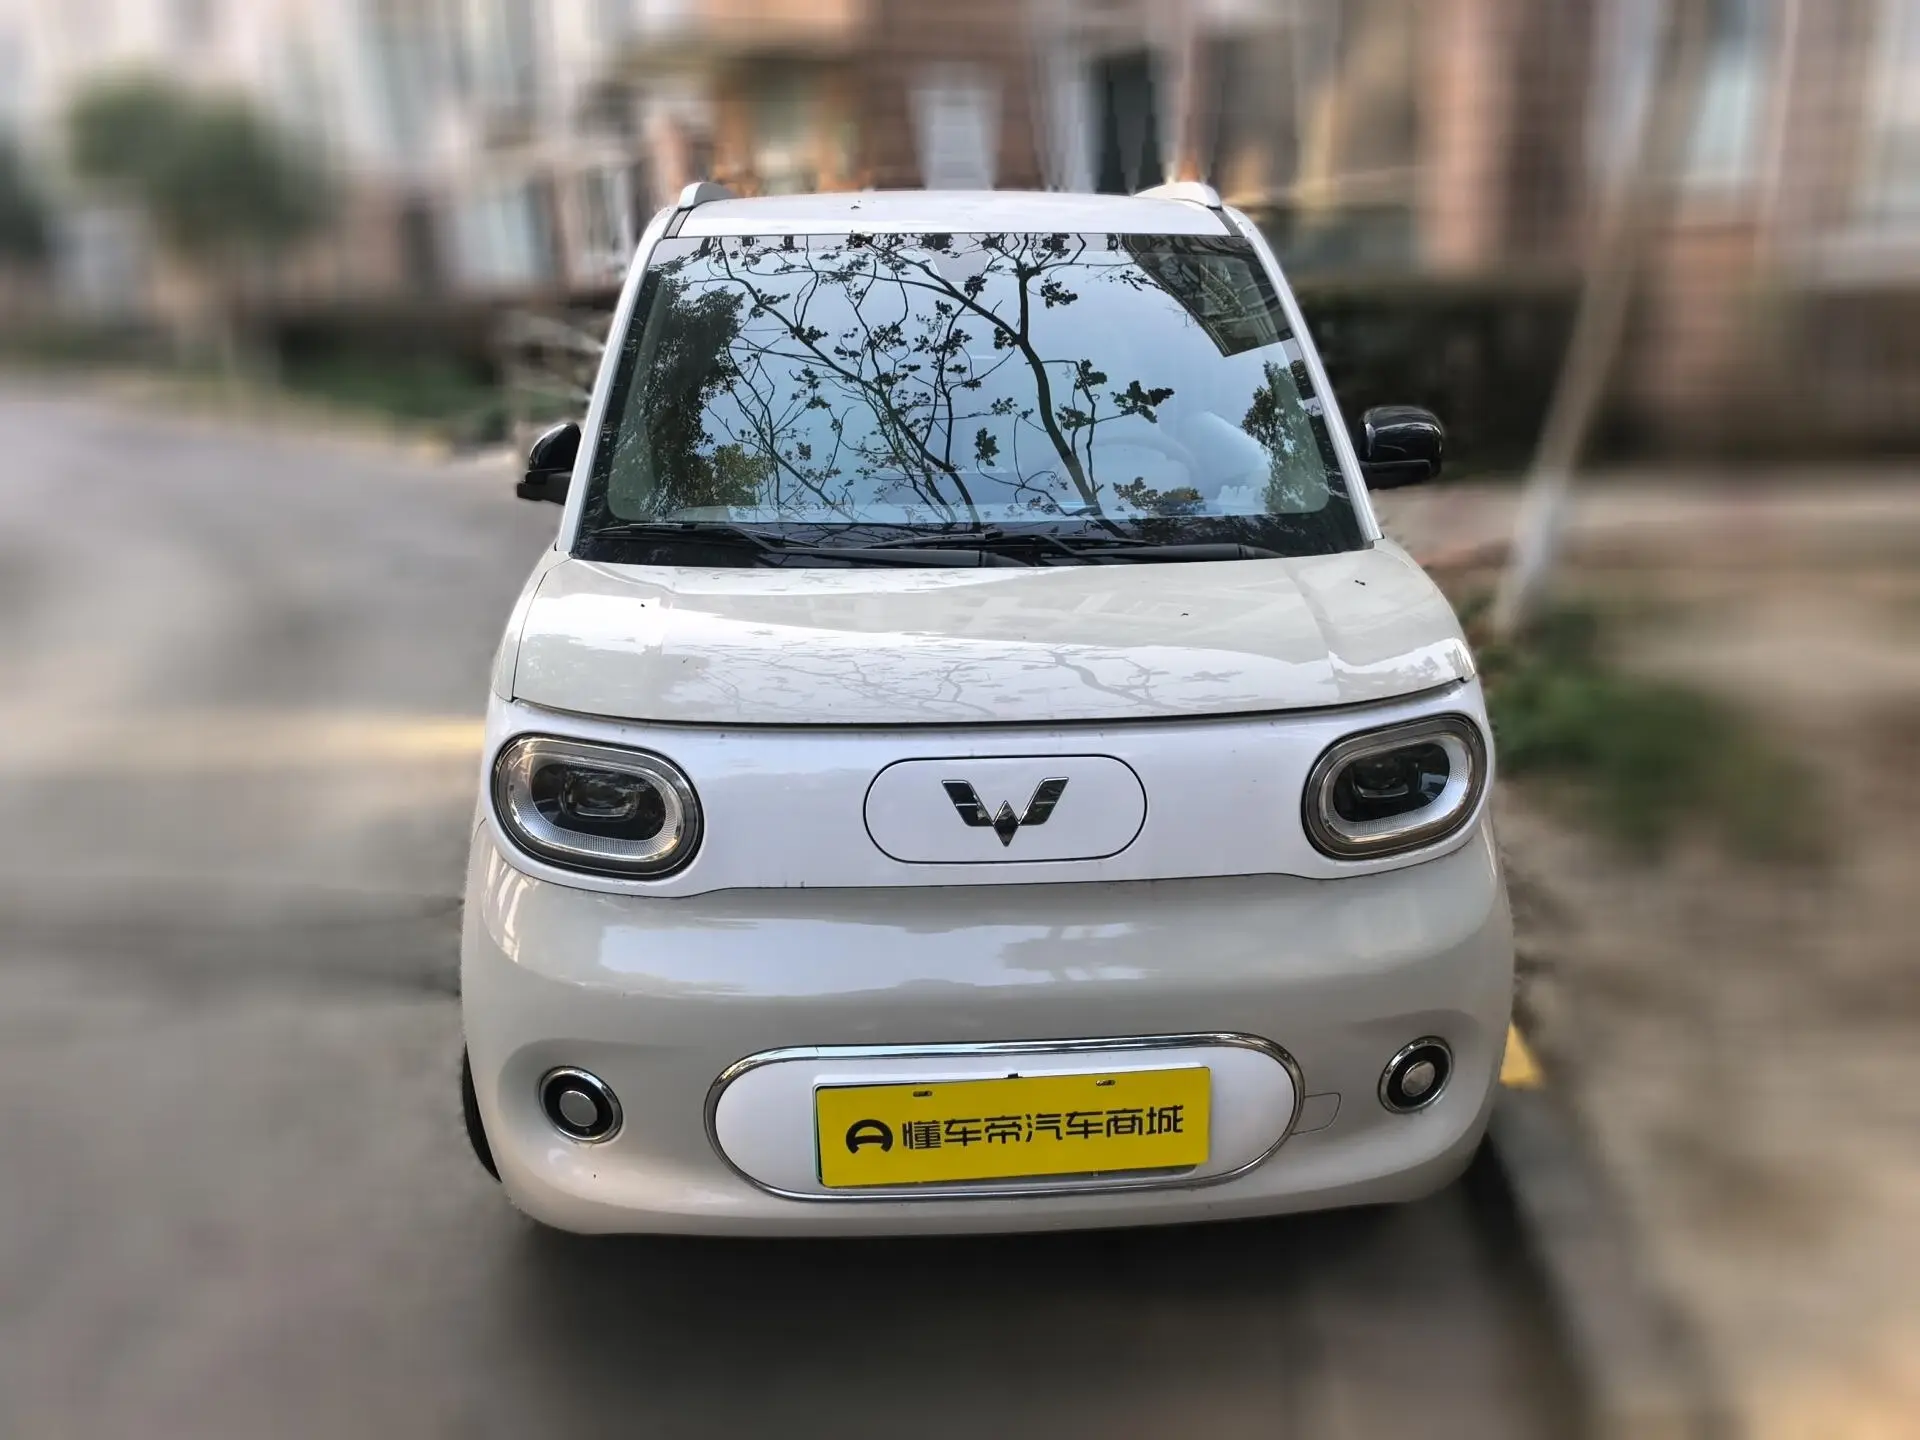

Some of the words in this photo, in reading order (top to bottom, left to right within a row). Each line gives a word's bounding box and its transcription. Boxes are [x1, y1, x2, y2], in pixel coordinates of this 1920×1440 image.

[902, 1105, 1184, 1149] 懂车帝汽车商城
